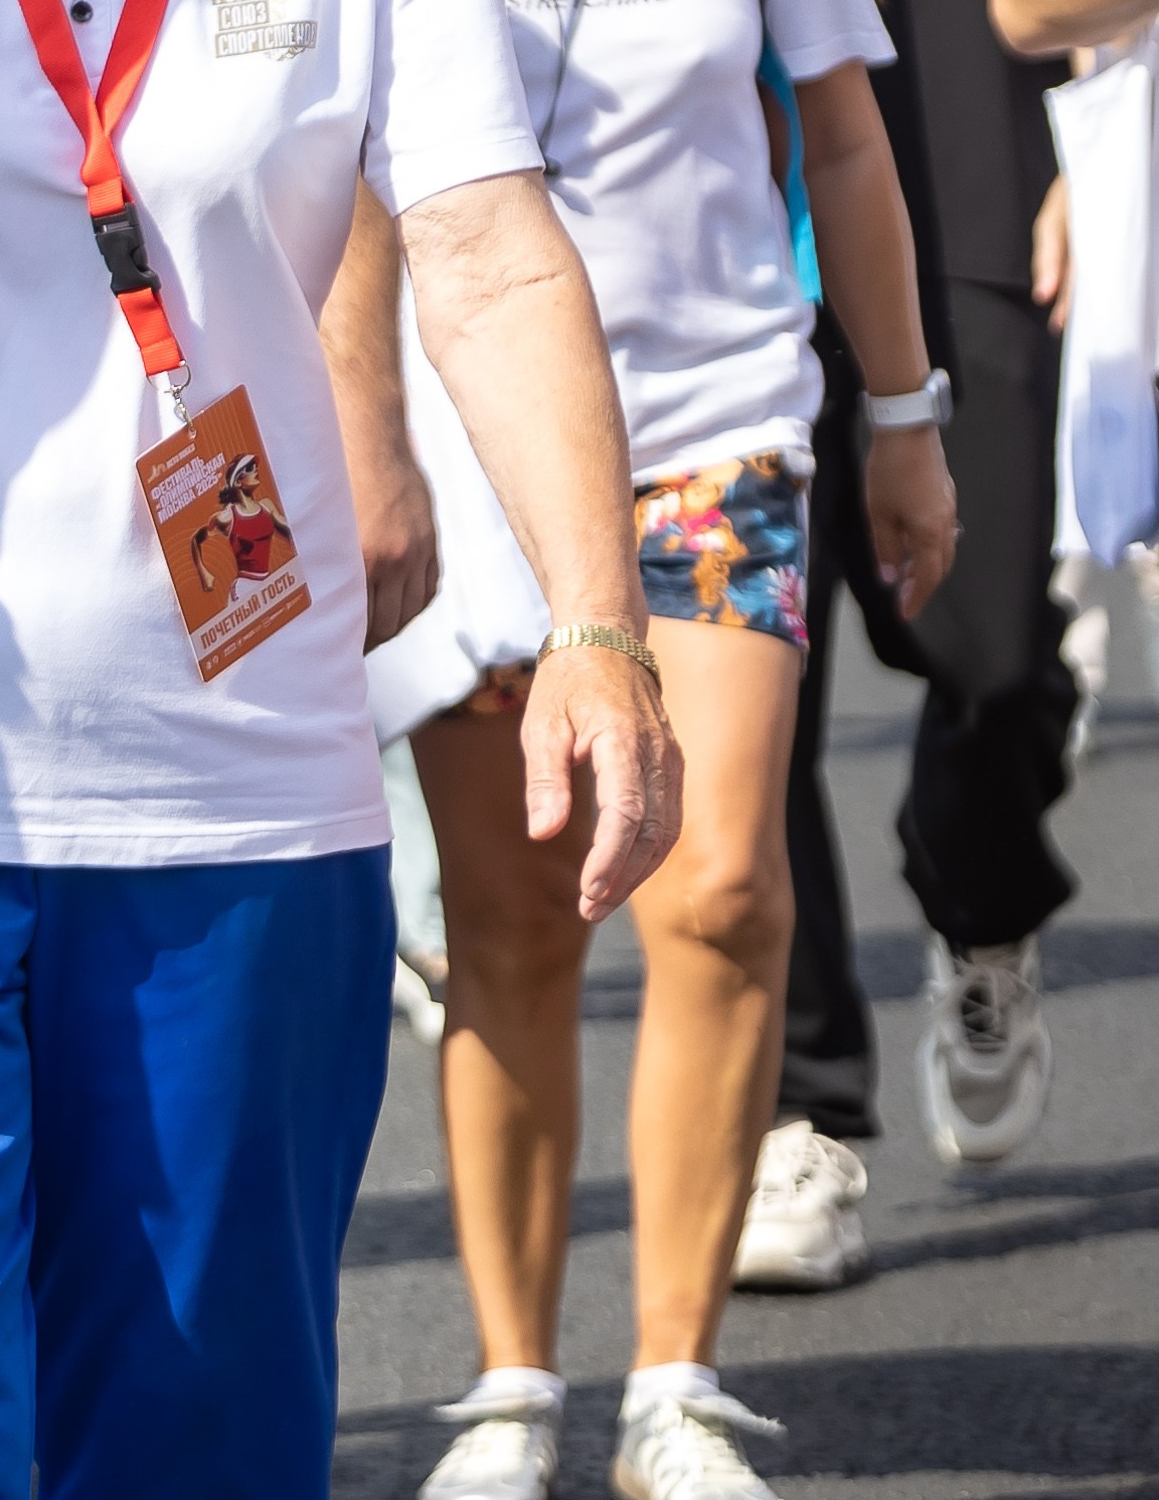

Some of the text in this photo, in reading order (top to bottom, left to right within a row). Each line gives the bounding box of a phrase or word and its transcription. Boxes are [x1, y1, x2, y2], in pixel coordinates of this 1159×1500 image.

[220, 1, 266, 30] СОЮЗ
[217, 22, 315, 56] СПОРТСМЕНОВ
[151, 456, 204, 500] ФЕСТИВАЛЬ
[158, 488, 196, 524] МОСКВА
[201, 594, 261, 650] ПОЧЕТНЫЙ
[260, 571, 296, 605] ГОСТЬ
